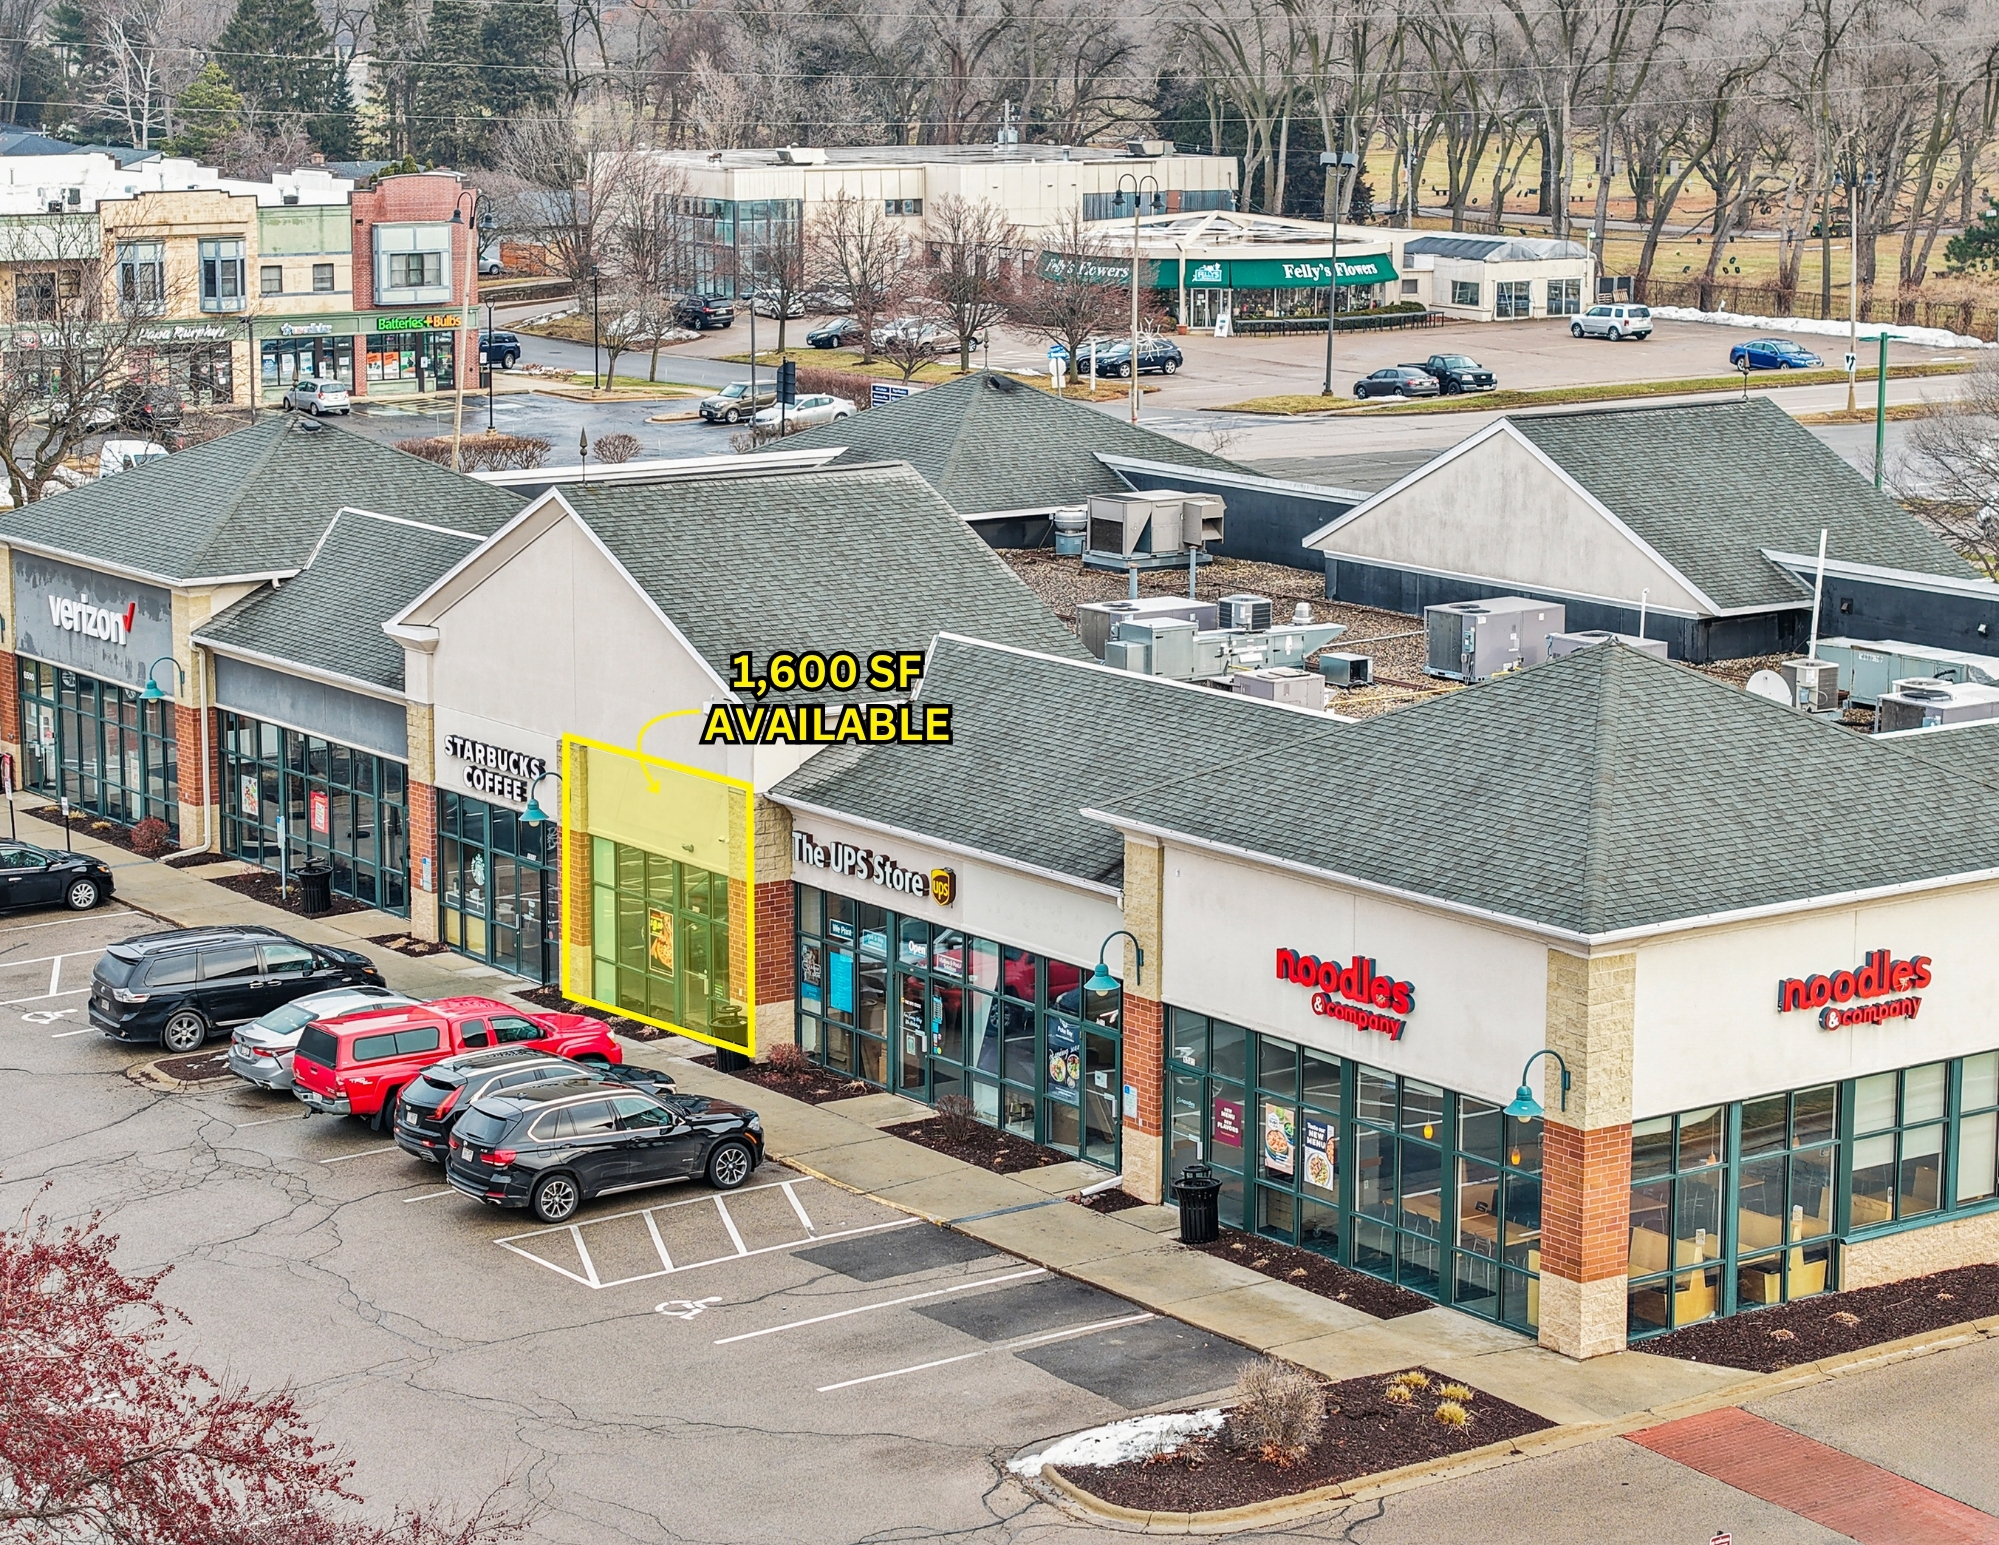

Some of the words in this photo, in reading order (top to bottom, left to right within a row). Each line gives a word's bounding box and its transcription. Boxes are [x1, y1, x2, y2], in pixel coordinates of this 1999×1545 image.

[1282, 263, 1332, 281] Felly's
[1334, 262, 1378, 277] Flowers
[48, 593, 126, 646] verizon
[444, 735, 543, 782] STARBUCKS
[463, 766, 524, 802] COFFEE
[792, 831, 827, 869] The
[830, 841, 870, 880] UPS
[873, 855, 926, 897] Store
[933, 880, 949, 900] ups
[908, 940, 926, 955] Open
[1277, 948, 1414, 1015] noodles
[1782, 949, 1932, 1012] noodles
[1306, 1136, 1326, 1149] MENU
[1308, 1129, 1325, 1141] NEW
